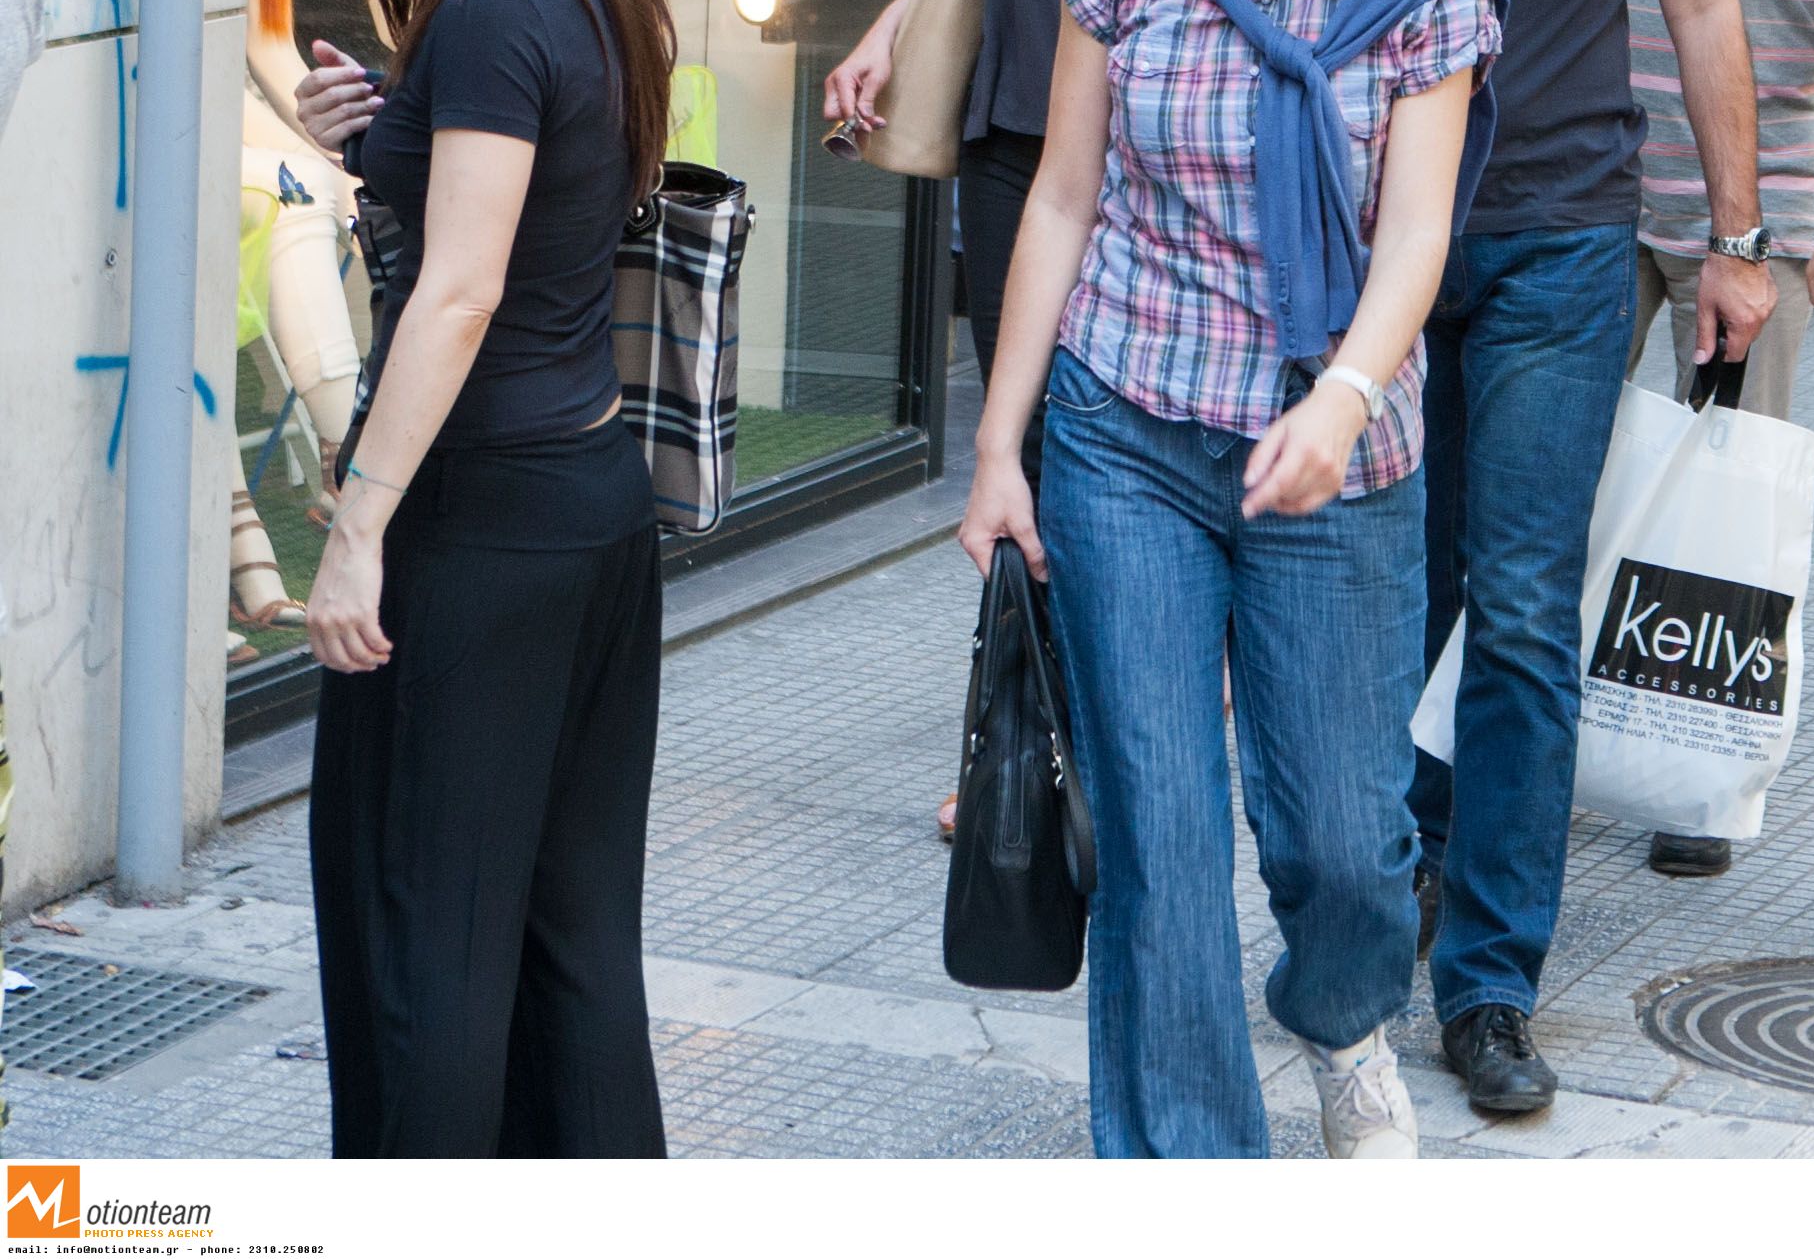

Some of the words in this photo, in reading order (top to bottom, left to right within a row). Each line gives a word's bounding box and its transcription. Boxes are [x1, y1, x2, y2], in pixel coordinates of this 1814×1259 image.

[1597, 664, 1778, 712] ACCESSORIES
[1594, 695, 1628, 712] ΣΟΦΙΑΣ
[1666, 712, 1688, 723] 2310
[1665, 699, 1686, 710] 2310
[1672, 725, 1688, 736] 210
